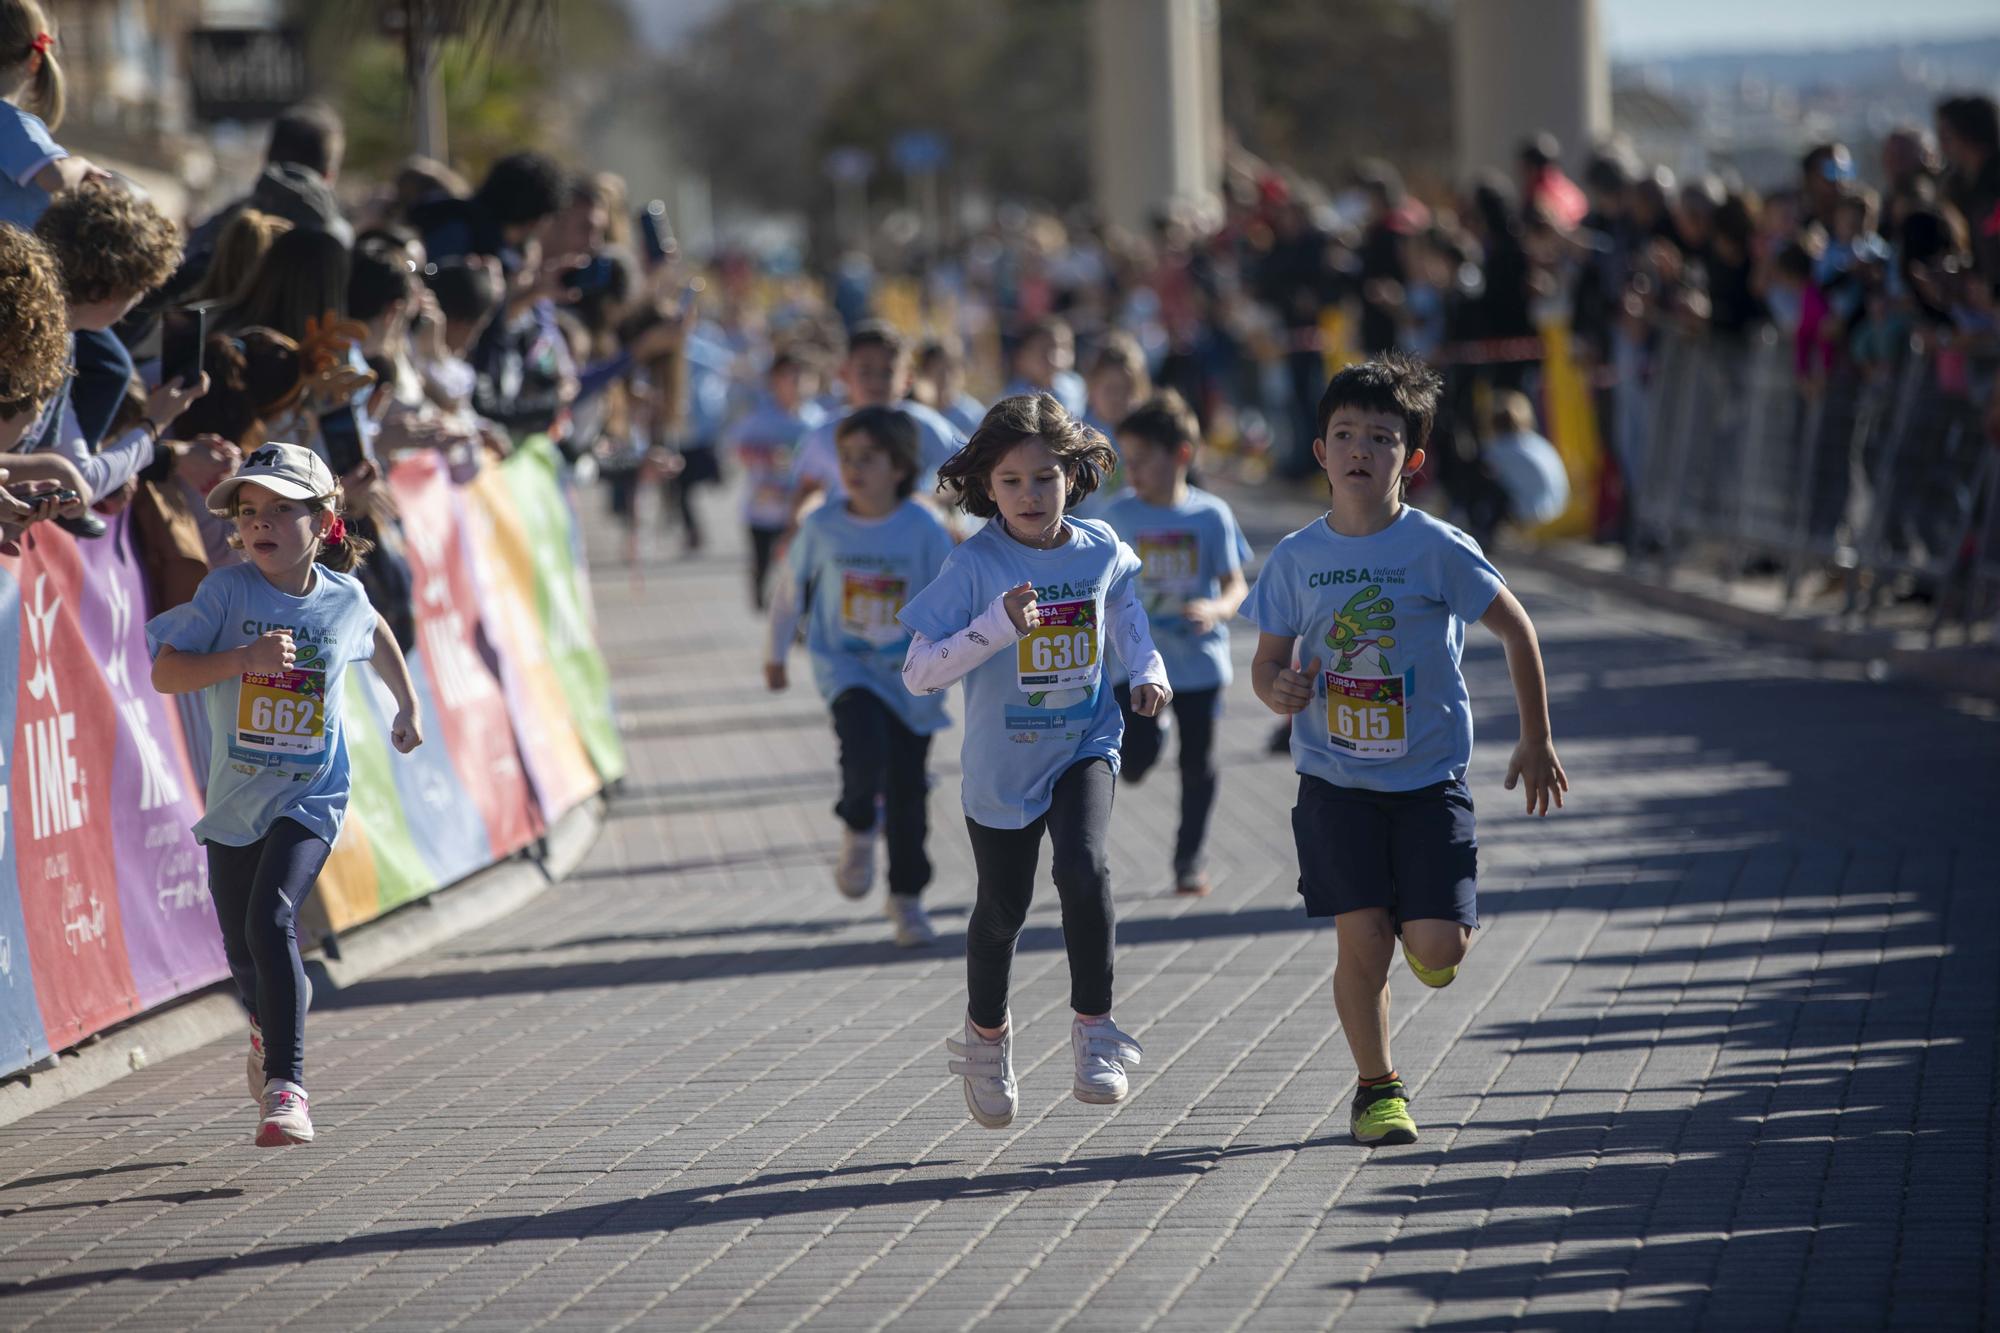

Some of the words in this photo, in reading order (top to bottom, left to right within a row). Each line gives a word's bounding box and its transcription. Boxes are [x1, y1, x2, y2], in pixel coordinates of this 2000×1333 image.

[244, 449, 280, 469] M
[1308, 567, 1372, 589] CURSA
[1373, 576, 1384, 584] de
[1387, 576, 1405, 585] Reis
[1034, 583, 1075, 603] RSA
[1031, 631, 1090, 671] 630
[1328, 674, 1358, 689] CURSA
[251, 696, 315, 735] 662
[1337, 704, 1391, 740] 615
